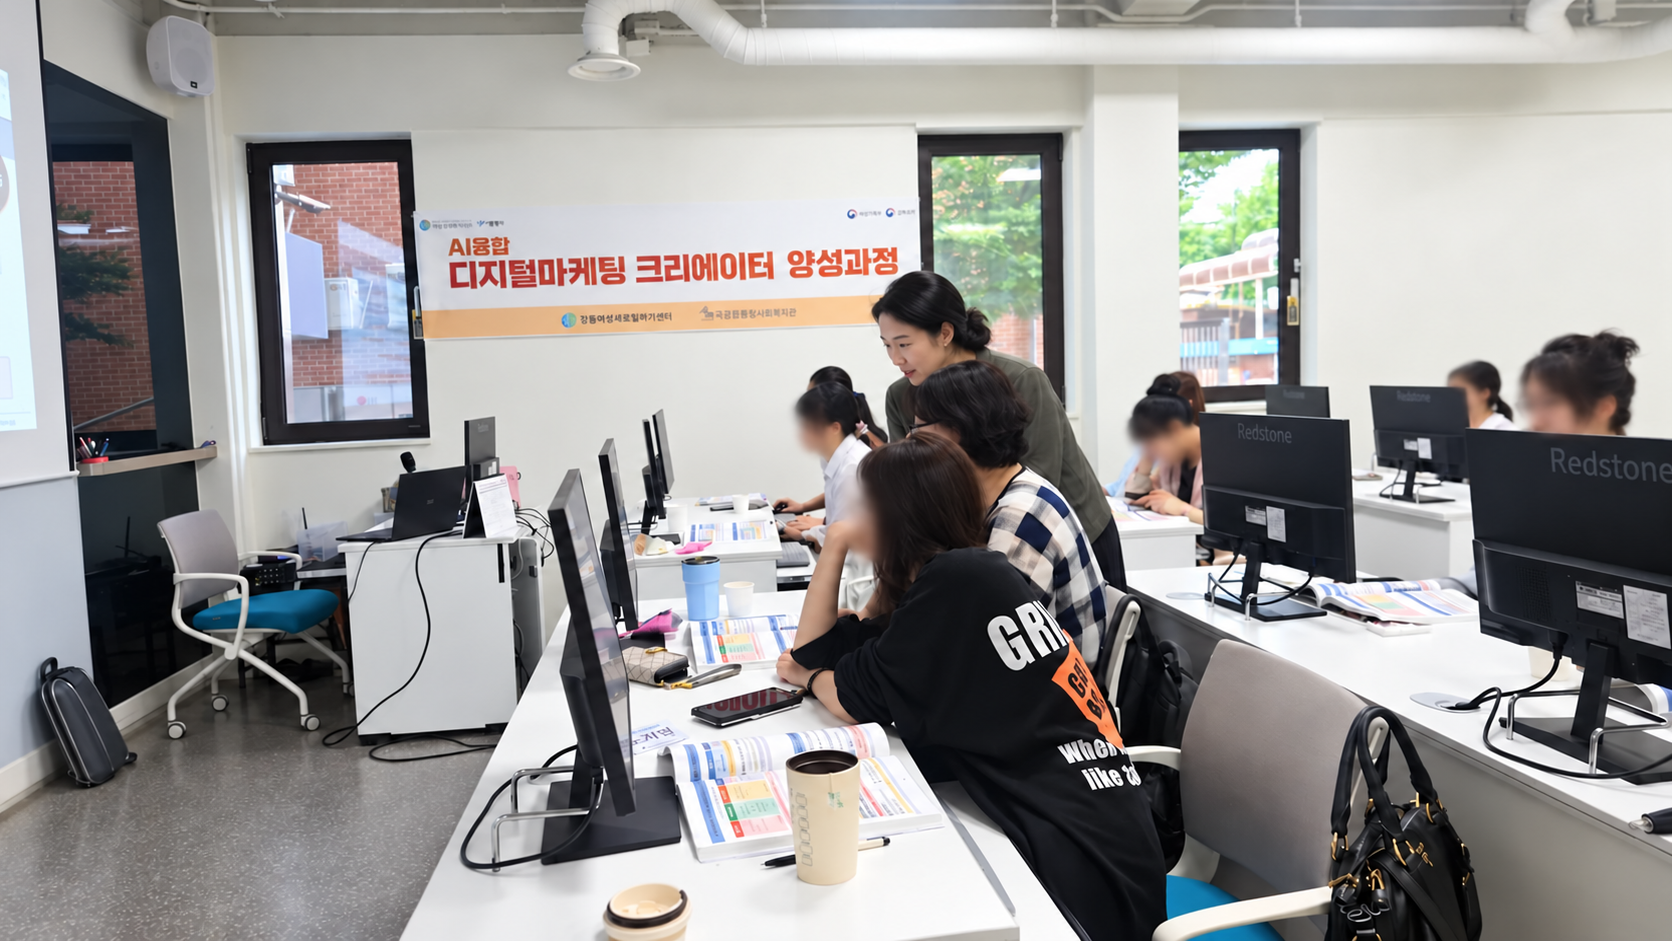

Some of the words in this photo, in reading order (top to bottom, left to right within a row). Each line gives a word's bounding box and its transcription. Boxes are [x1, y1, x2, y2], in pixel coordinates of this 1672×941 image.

[448, 237, 510, 257] AI융합
[449, 256, 627, 289] 디지털마케팅
[636, 251, 775, 283] 크리에이터
[787, 247, 899, 279] 양성과정
[1237, 422, 1292, 444] Redstone
[1550, 447, 1672, 484] Redstone
